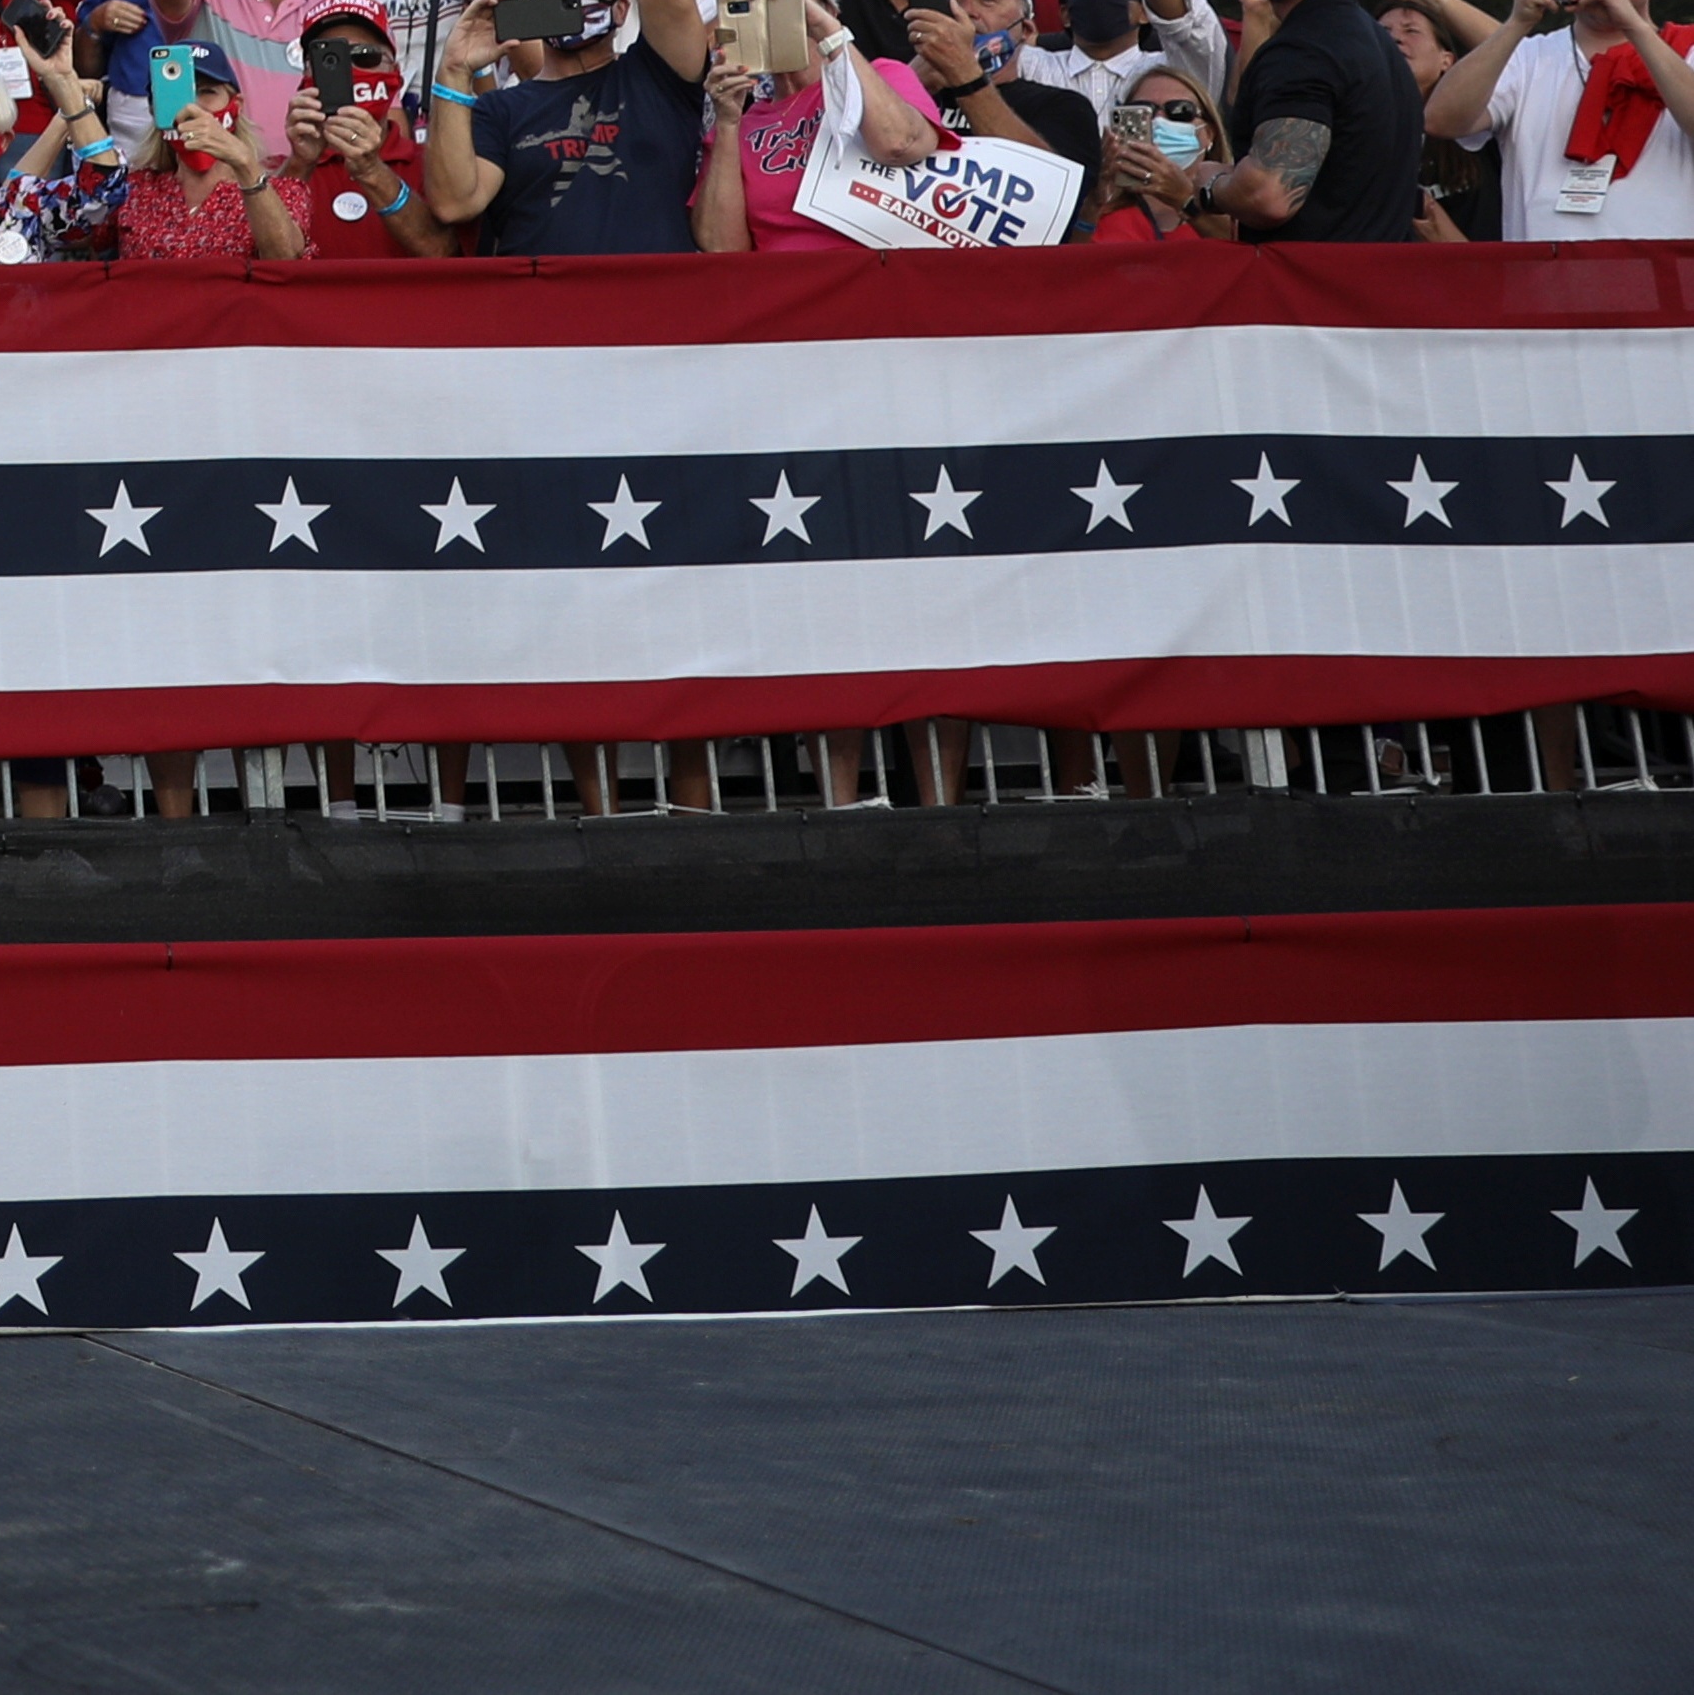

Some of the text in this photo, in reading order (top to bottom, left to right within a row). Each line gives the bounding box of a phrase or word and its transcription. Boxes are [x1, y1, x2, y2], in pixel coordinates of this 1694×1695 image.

[353, 81, 388, 102] GA
[859, 159, 1027, 247] THE VOTE
[908, 156, 1035, 207] UMP
[878, 193, 936, 230] EARLY
